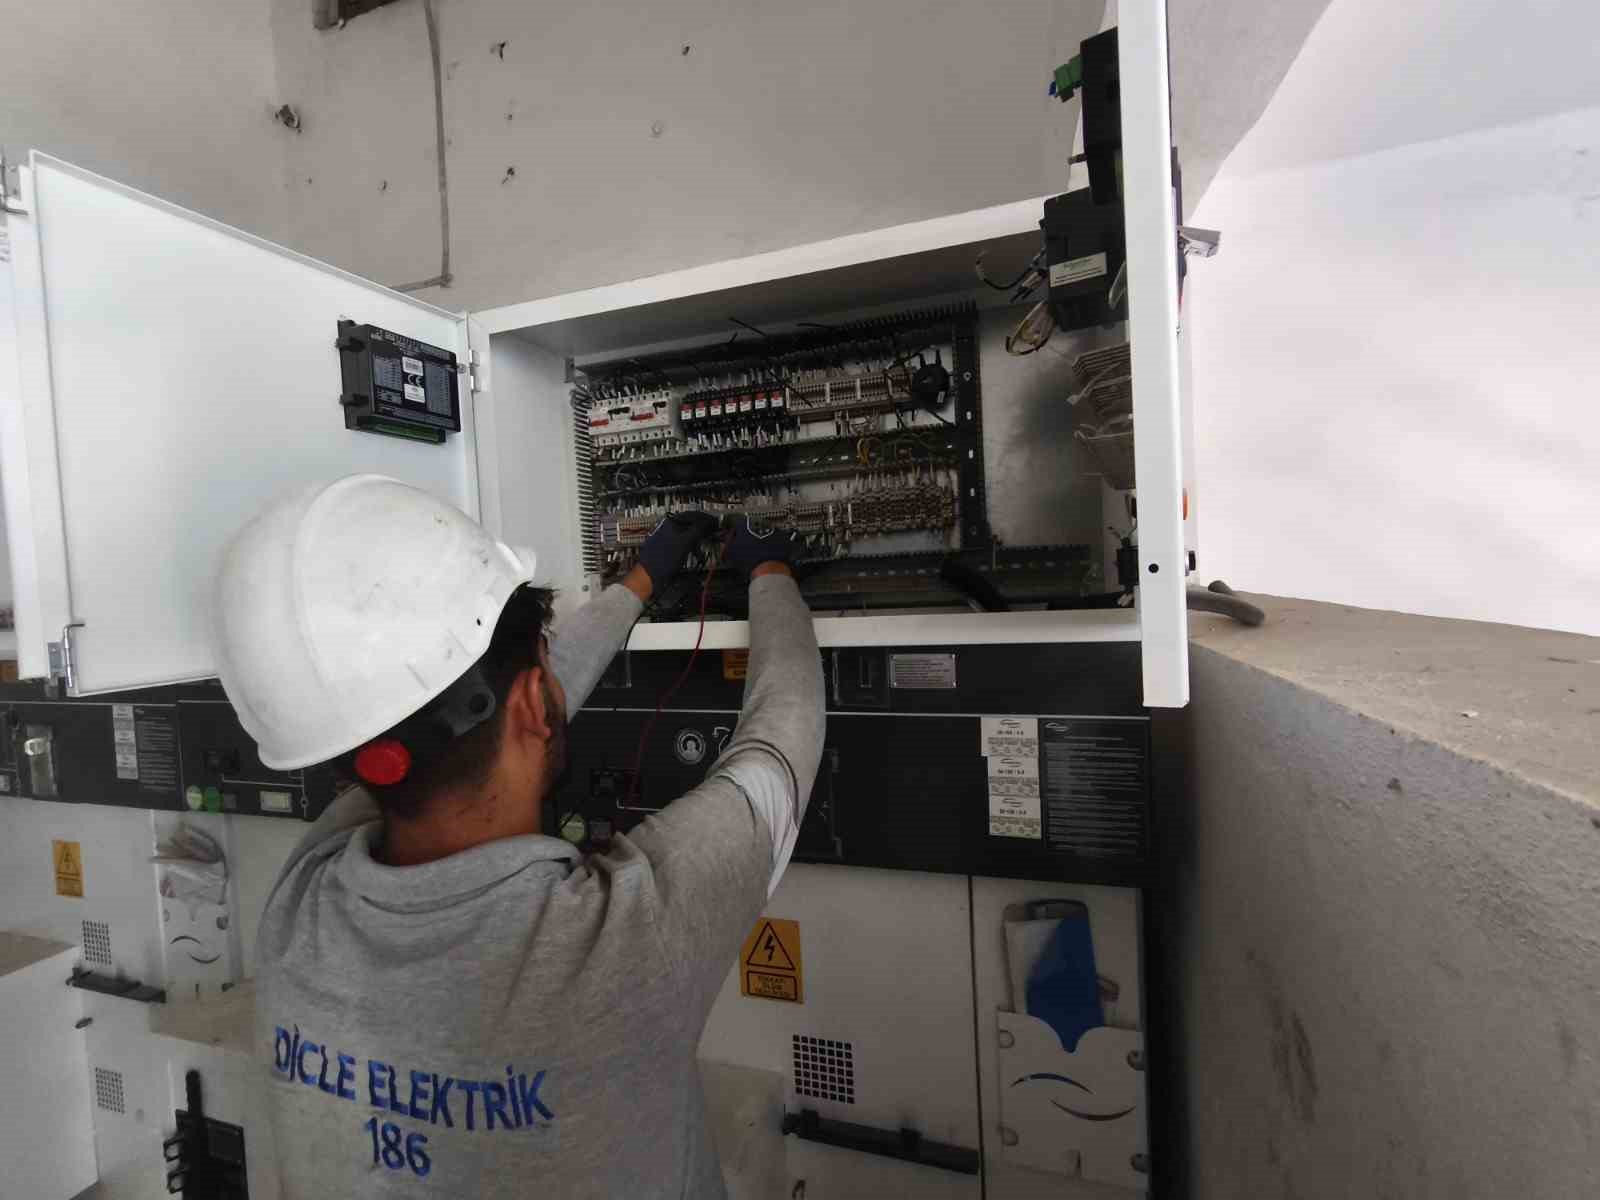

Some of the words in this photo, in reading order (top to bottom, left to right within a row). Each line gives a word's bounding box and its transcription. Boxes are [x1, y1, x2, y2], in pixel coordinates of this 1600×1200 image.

[275, 1023, 356, 1100] DİCLE
[367, 1059, 554, 1131] ELEKTRİK
[365, 1116, 432, 1177] 186
